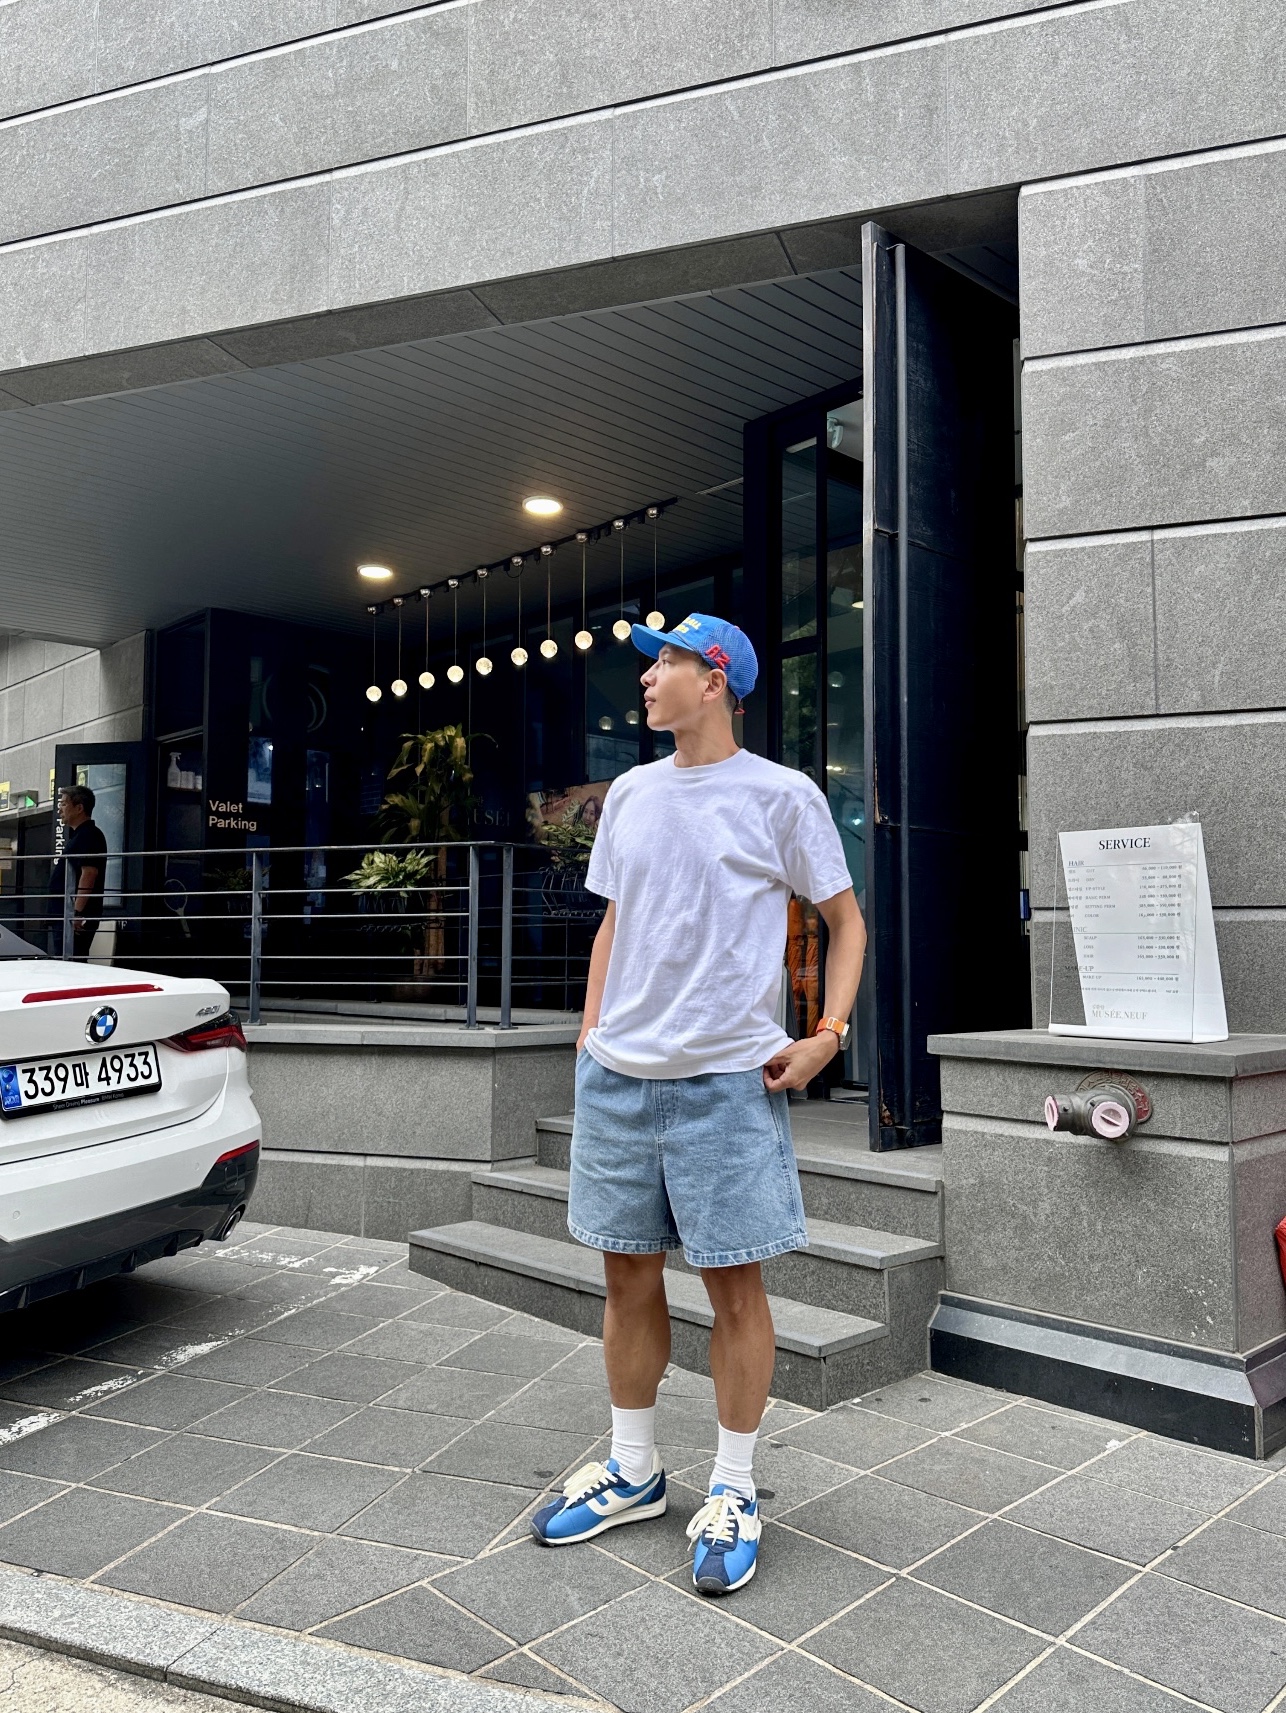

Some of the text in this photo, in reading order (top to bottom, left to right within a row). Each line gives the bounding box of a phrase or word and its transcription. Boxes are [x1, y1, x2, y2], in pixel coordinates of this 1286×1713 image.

[209, 799, 243, 813] Valet
[209, 815, 257, 832] Parking
[1098, 837, 1151, 850] SERVICE
[21, 1050, 153, 1100] 339마 4933
[81, 1097, 100, 1105] Pleasure
